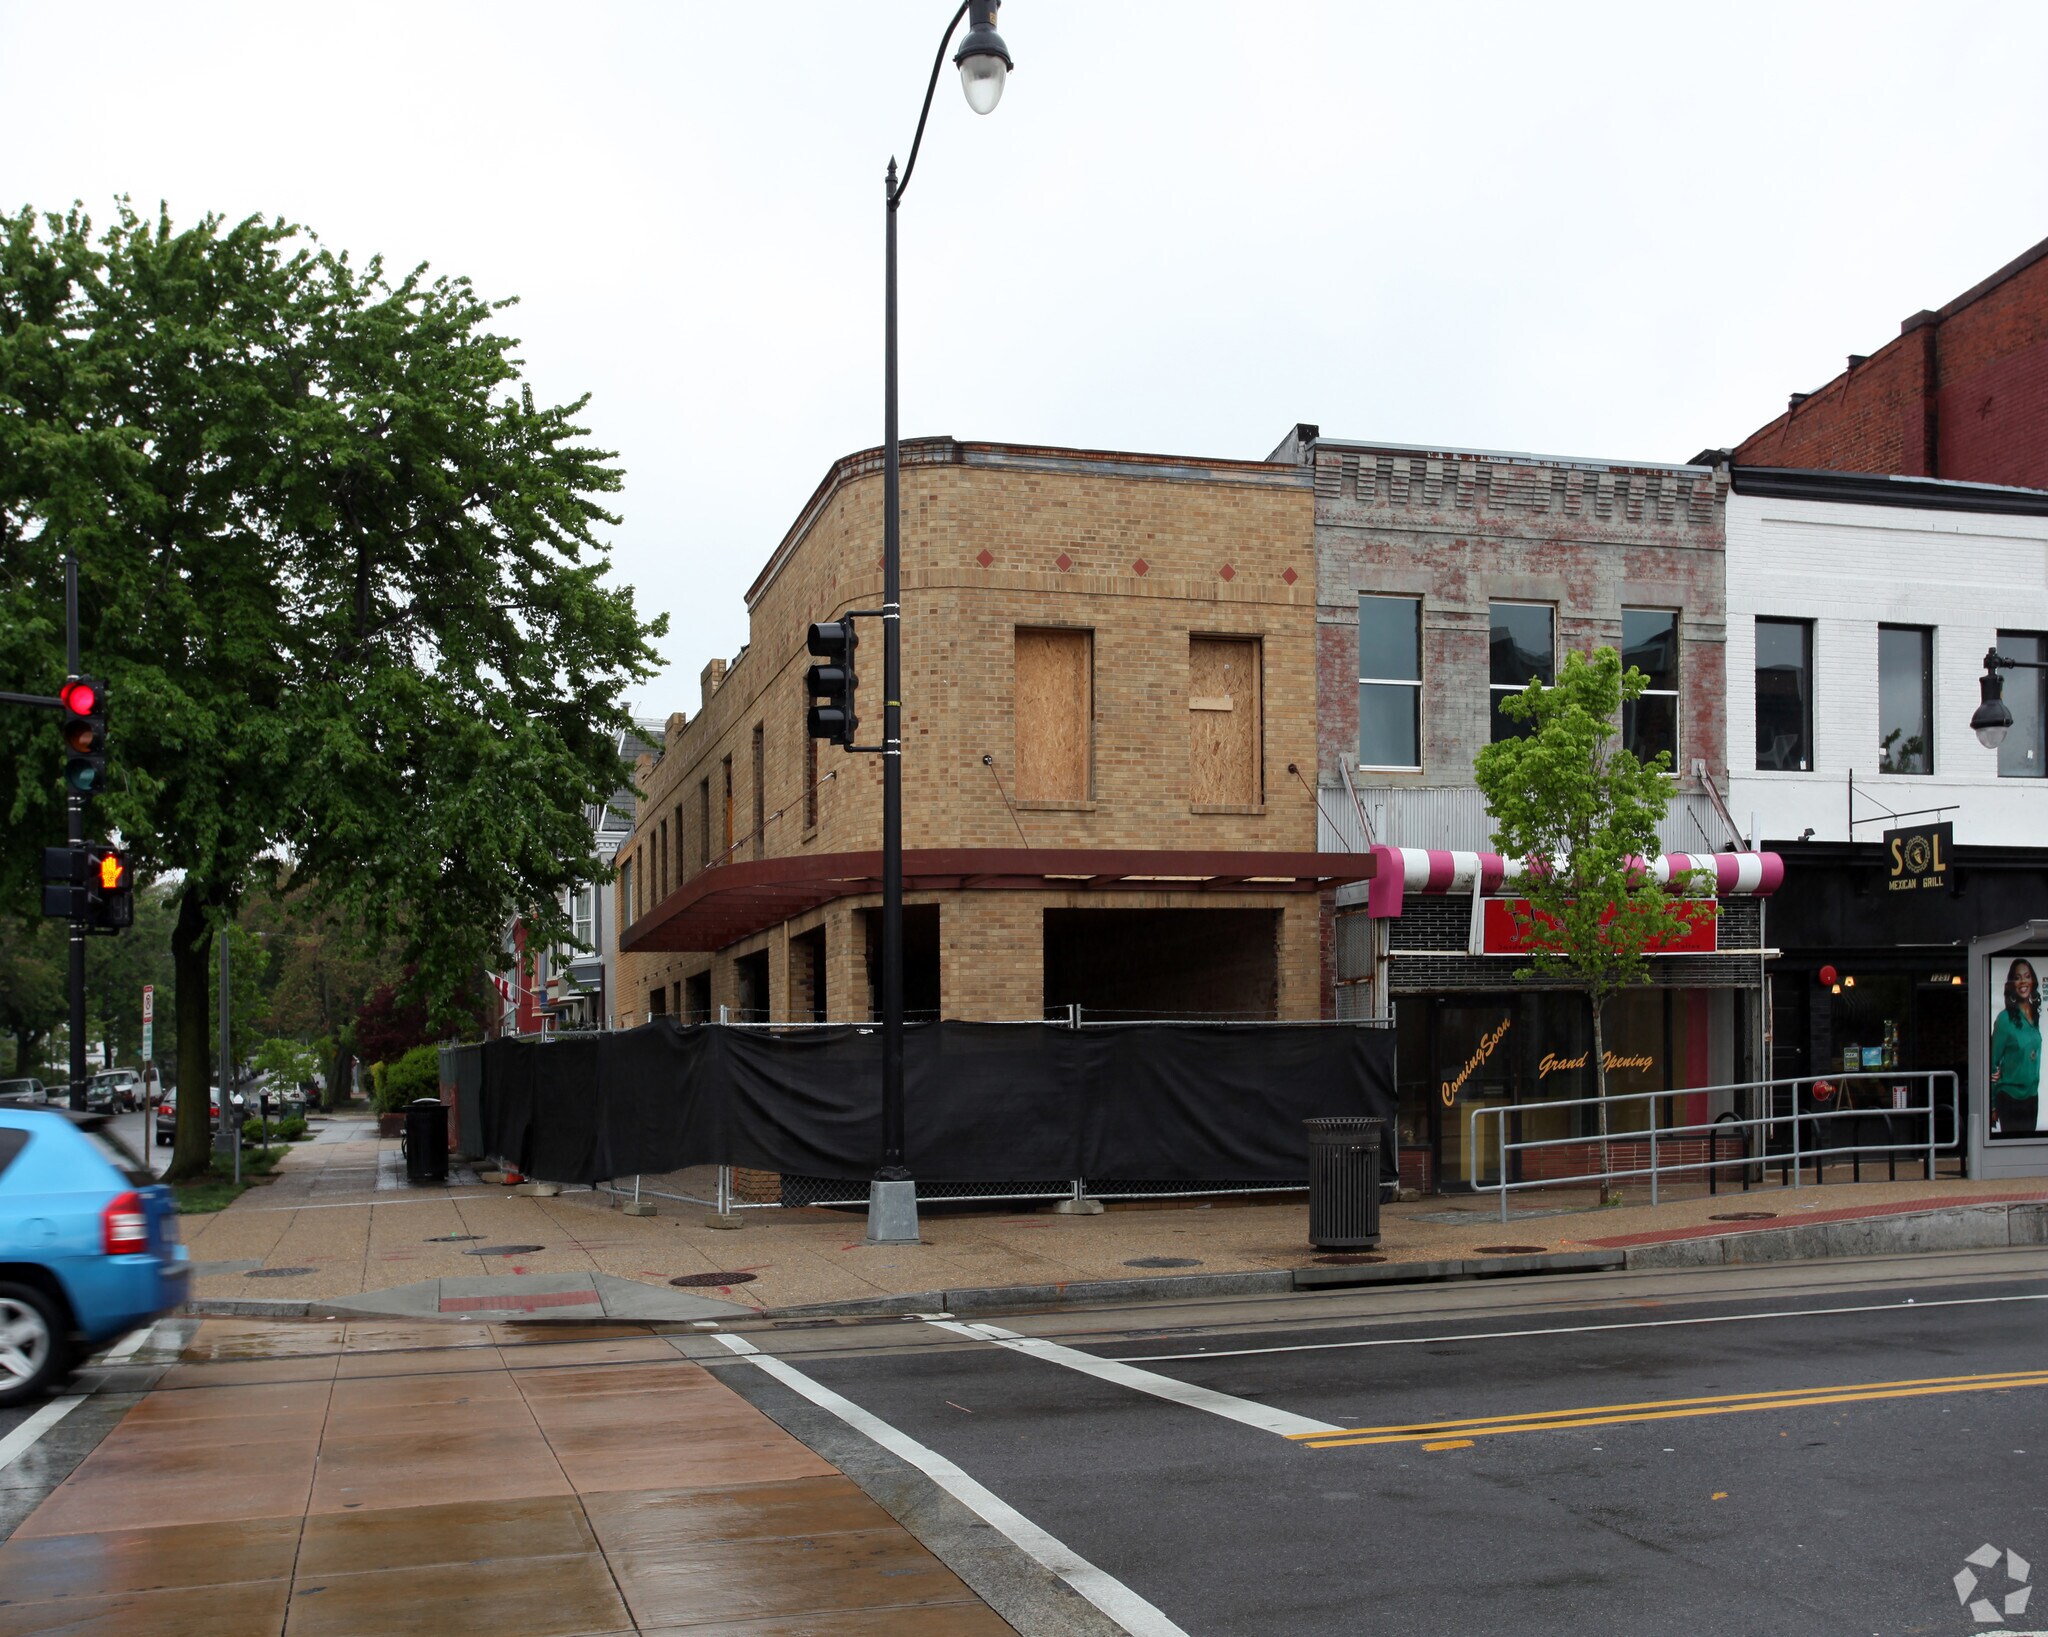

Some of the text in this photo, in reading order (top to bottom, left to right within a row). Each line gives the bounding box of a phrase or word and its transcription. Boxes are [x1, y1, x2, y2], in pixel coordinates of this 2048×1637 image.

[1889, 876, 1944, 891] MEXICAN GRILL
[1539, 1050, 1654, 1079] Grand Opening
